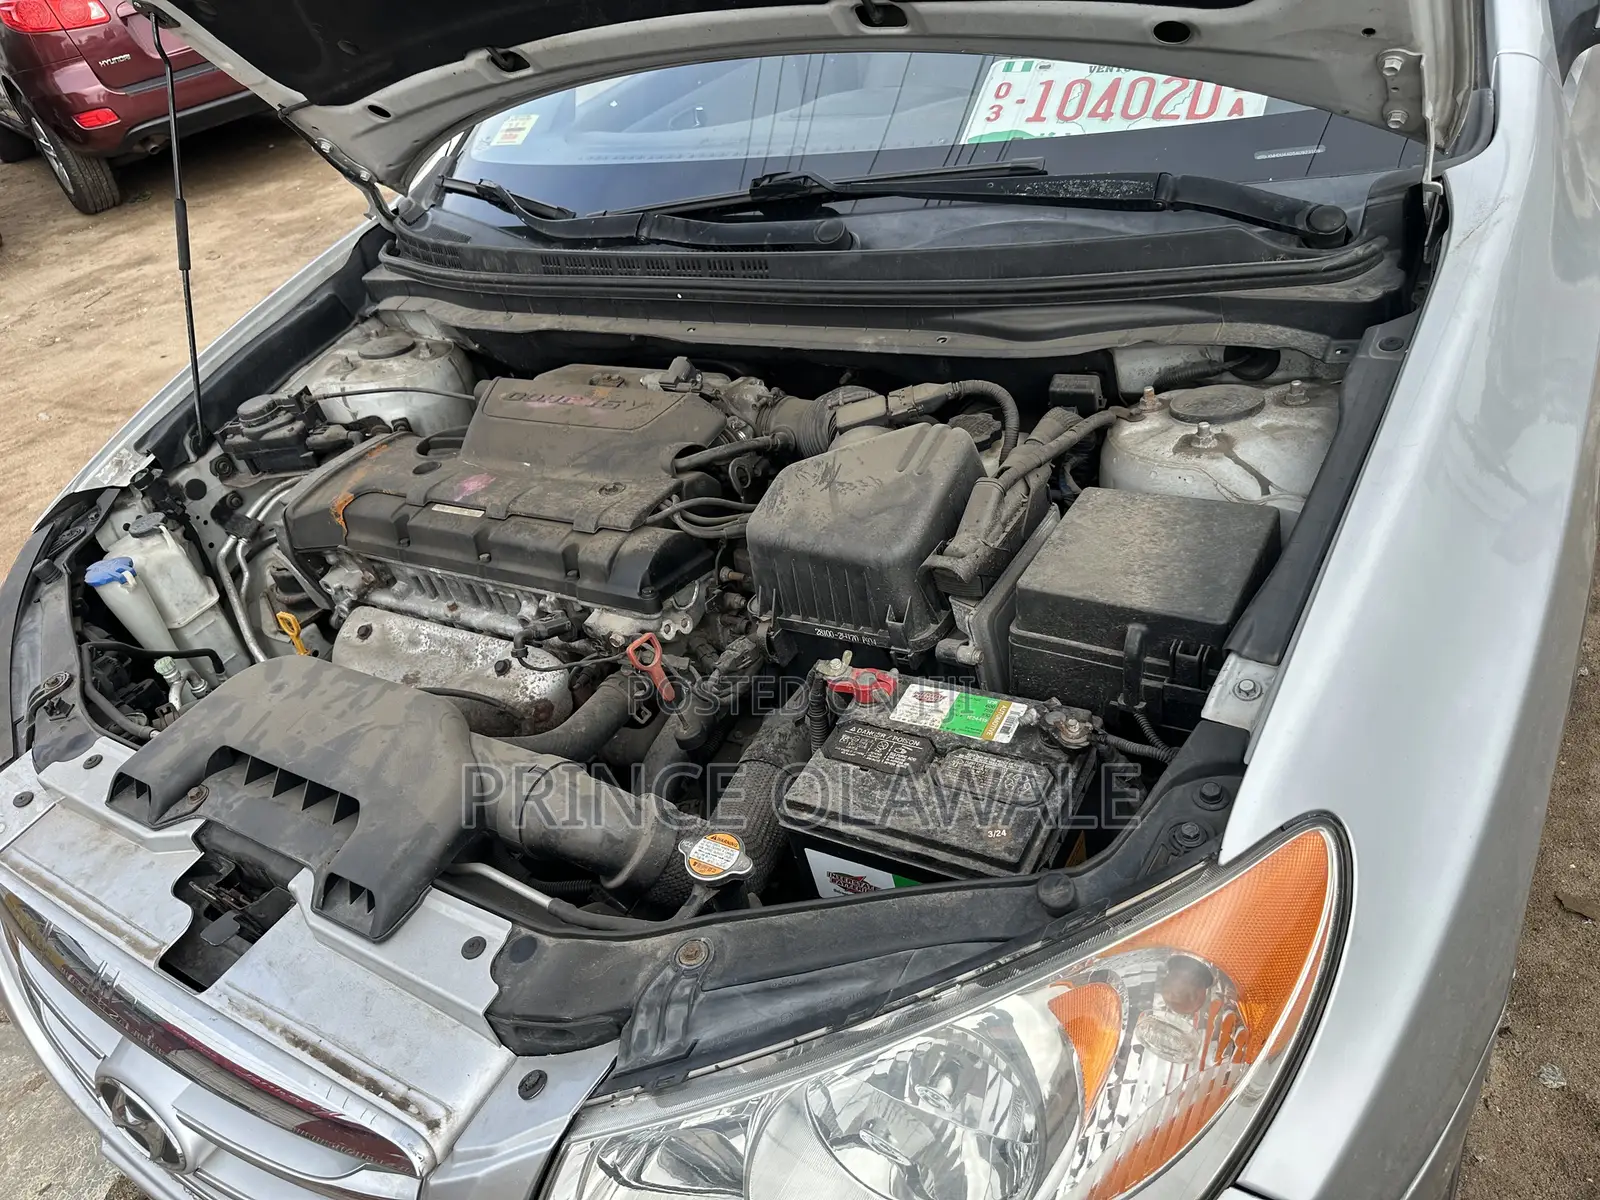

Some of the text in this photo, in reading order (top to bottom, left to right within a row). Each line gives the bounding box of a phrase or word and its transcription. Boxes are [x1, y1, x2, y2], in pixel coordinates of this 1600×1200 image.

[99, 53, 131, 67] HYUNDAI
[986, 704, 1008, 737] AUTOMOTIVE
[856, 727, 887, 739] DANGER
[892, 735, 921, 747] POISON
[987, 829, 1007, 838] 3/24
